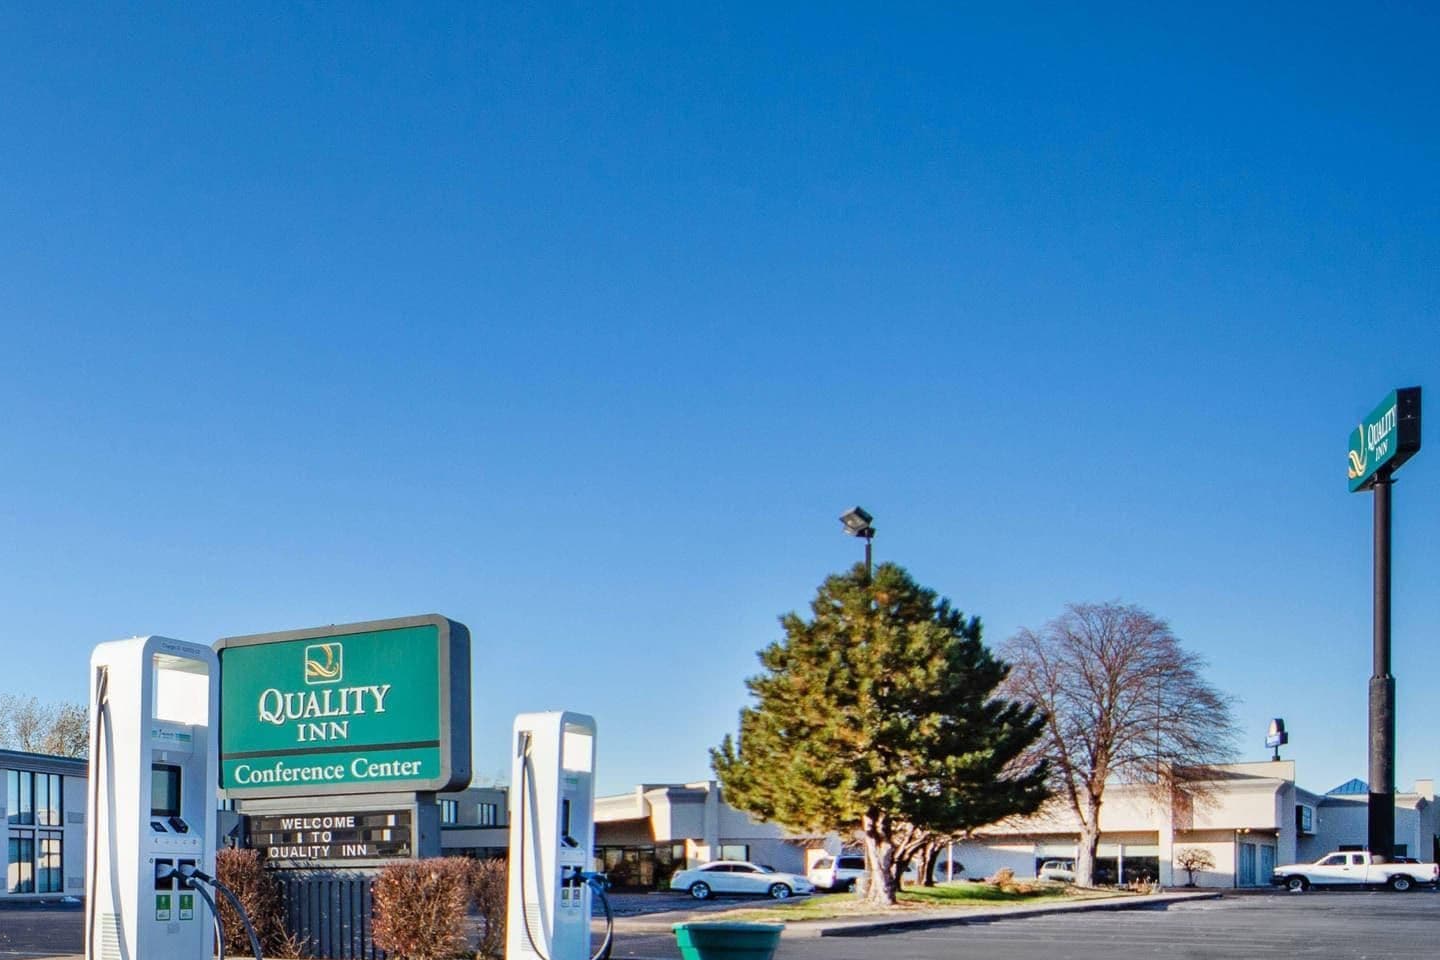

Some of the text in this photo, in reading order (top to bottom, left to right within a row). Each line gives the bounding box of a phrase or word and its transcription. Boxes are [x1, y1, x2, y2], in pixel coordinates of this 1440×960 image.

[1368, 404, 1396, 451] QUALITY
[1375, 439, 1388, 462] INN
[259, 684, 391, 725] QUALITY
[296, 721, 350, 742] INN
[234, 758, 422, 784] Conference Center
[281, 816, 356, 830] WELCOME
[312, 831, 332, 843] TO
[269, 844, 367, 858] QUALITY INN
